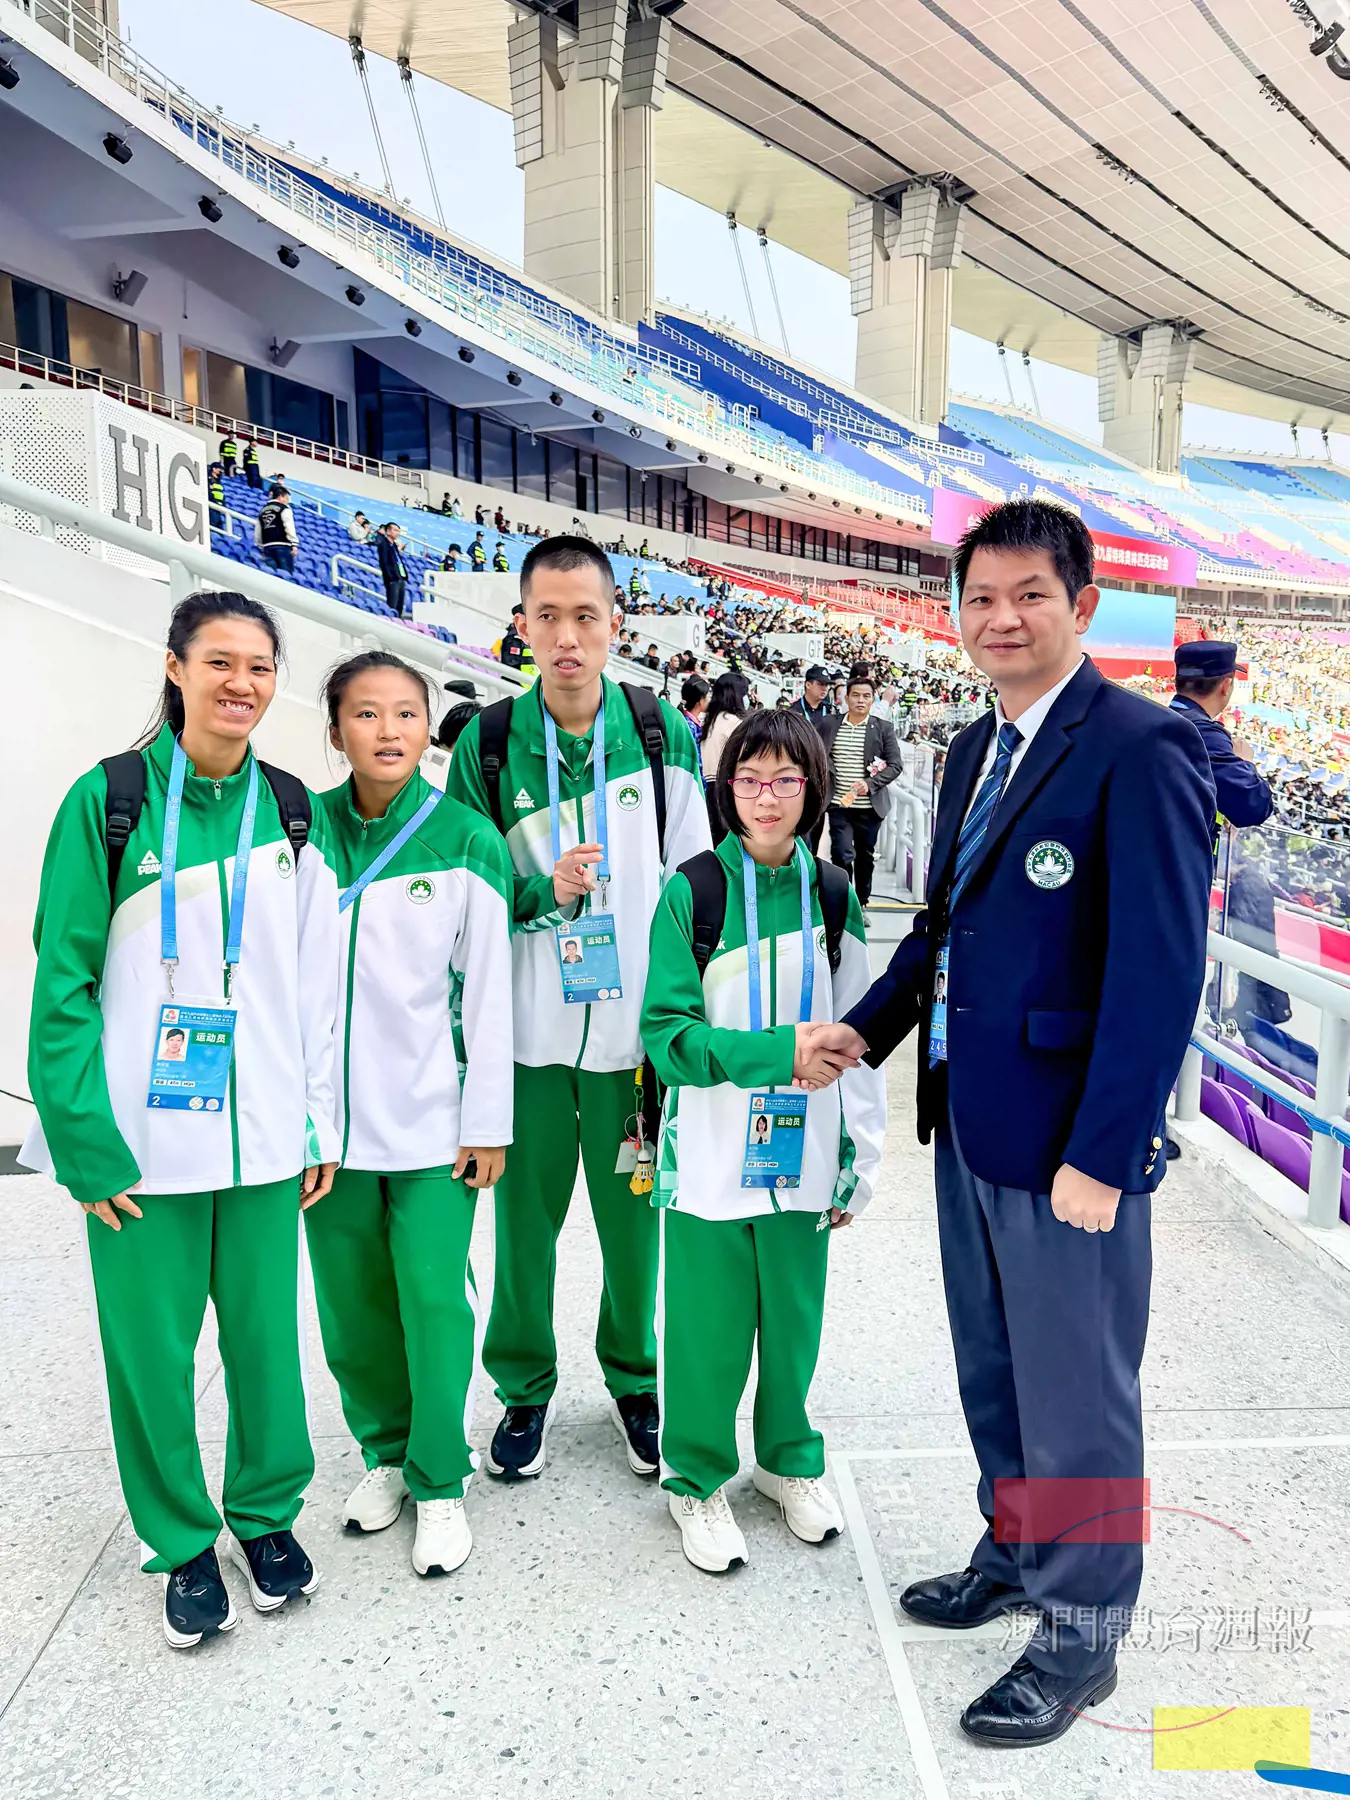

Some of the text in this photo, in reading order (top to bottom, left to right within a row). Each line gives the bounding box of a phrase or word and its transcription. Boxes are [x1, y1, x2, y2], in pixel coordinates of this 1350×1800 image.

[514, 799, 536, 809] PEAK
[1037, 879, 1061, 888] MACAU
[586, 935, 611, 945] 运动员
[567, 992, 574, 1001] 2
[195, 1032, 226, 1044] 运动员
[152, 1095, 161, 1106] 2
[777, 1117, 801, 1126] 运动员
[745, 1176, 752, 1186] 2
